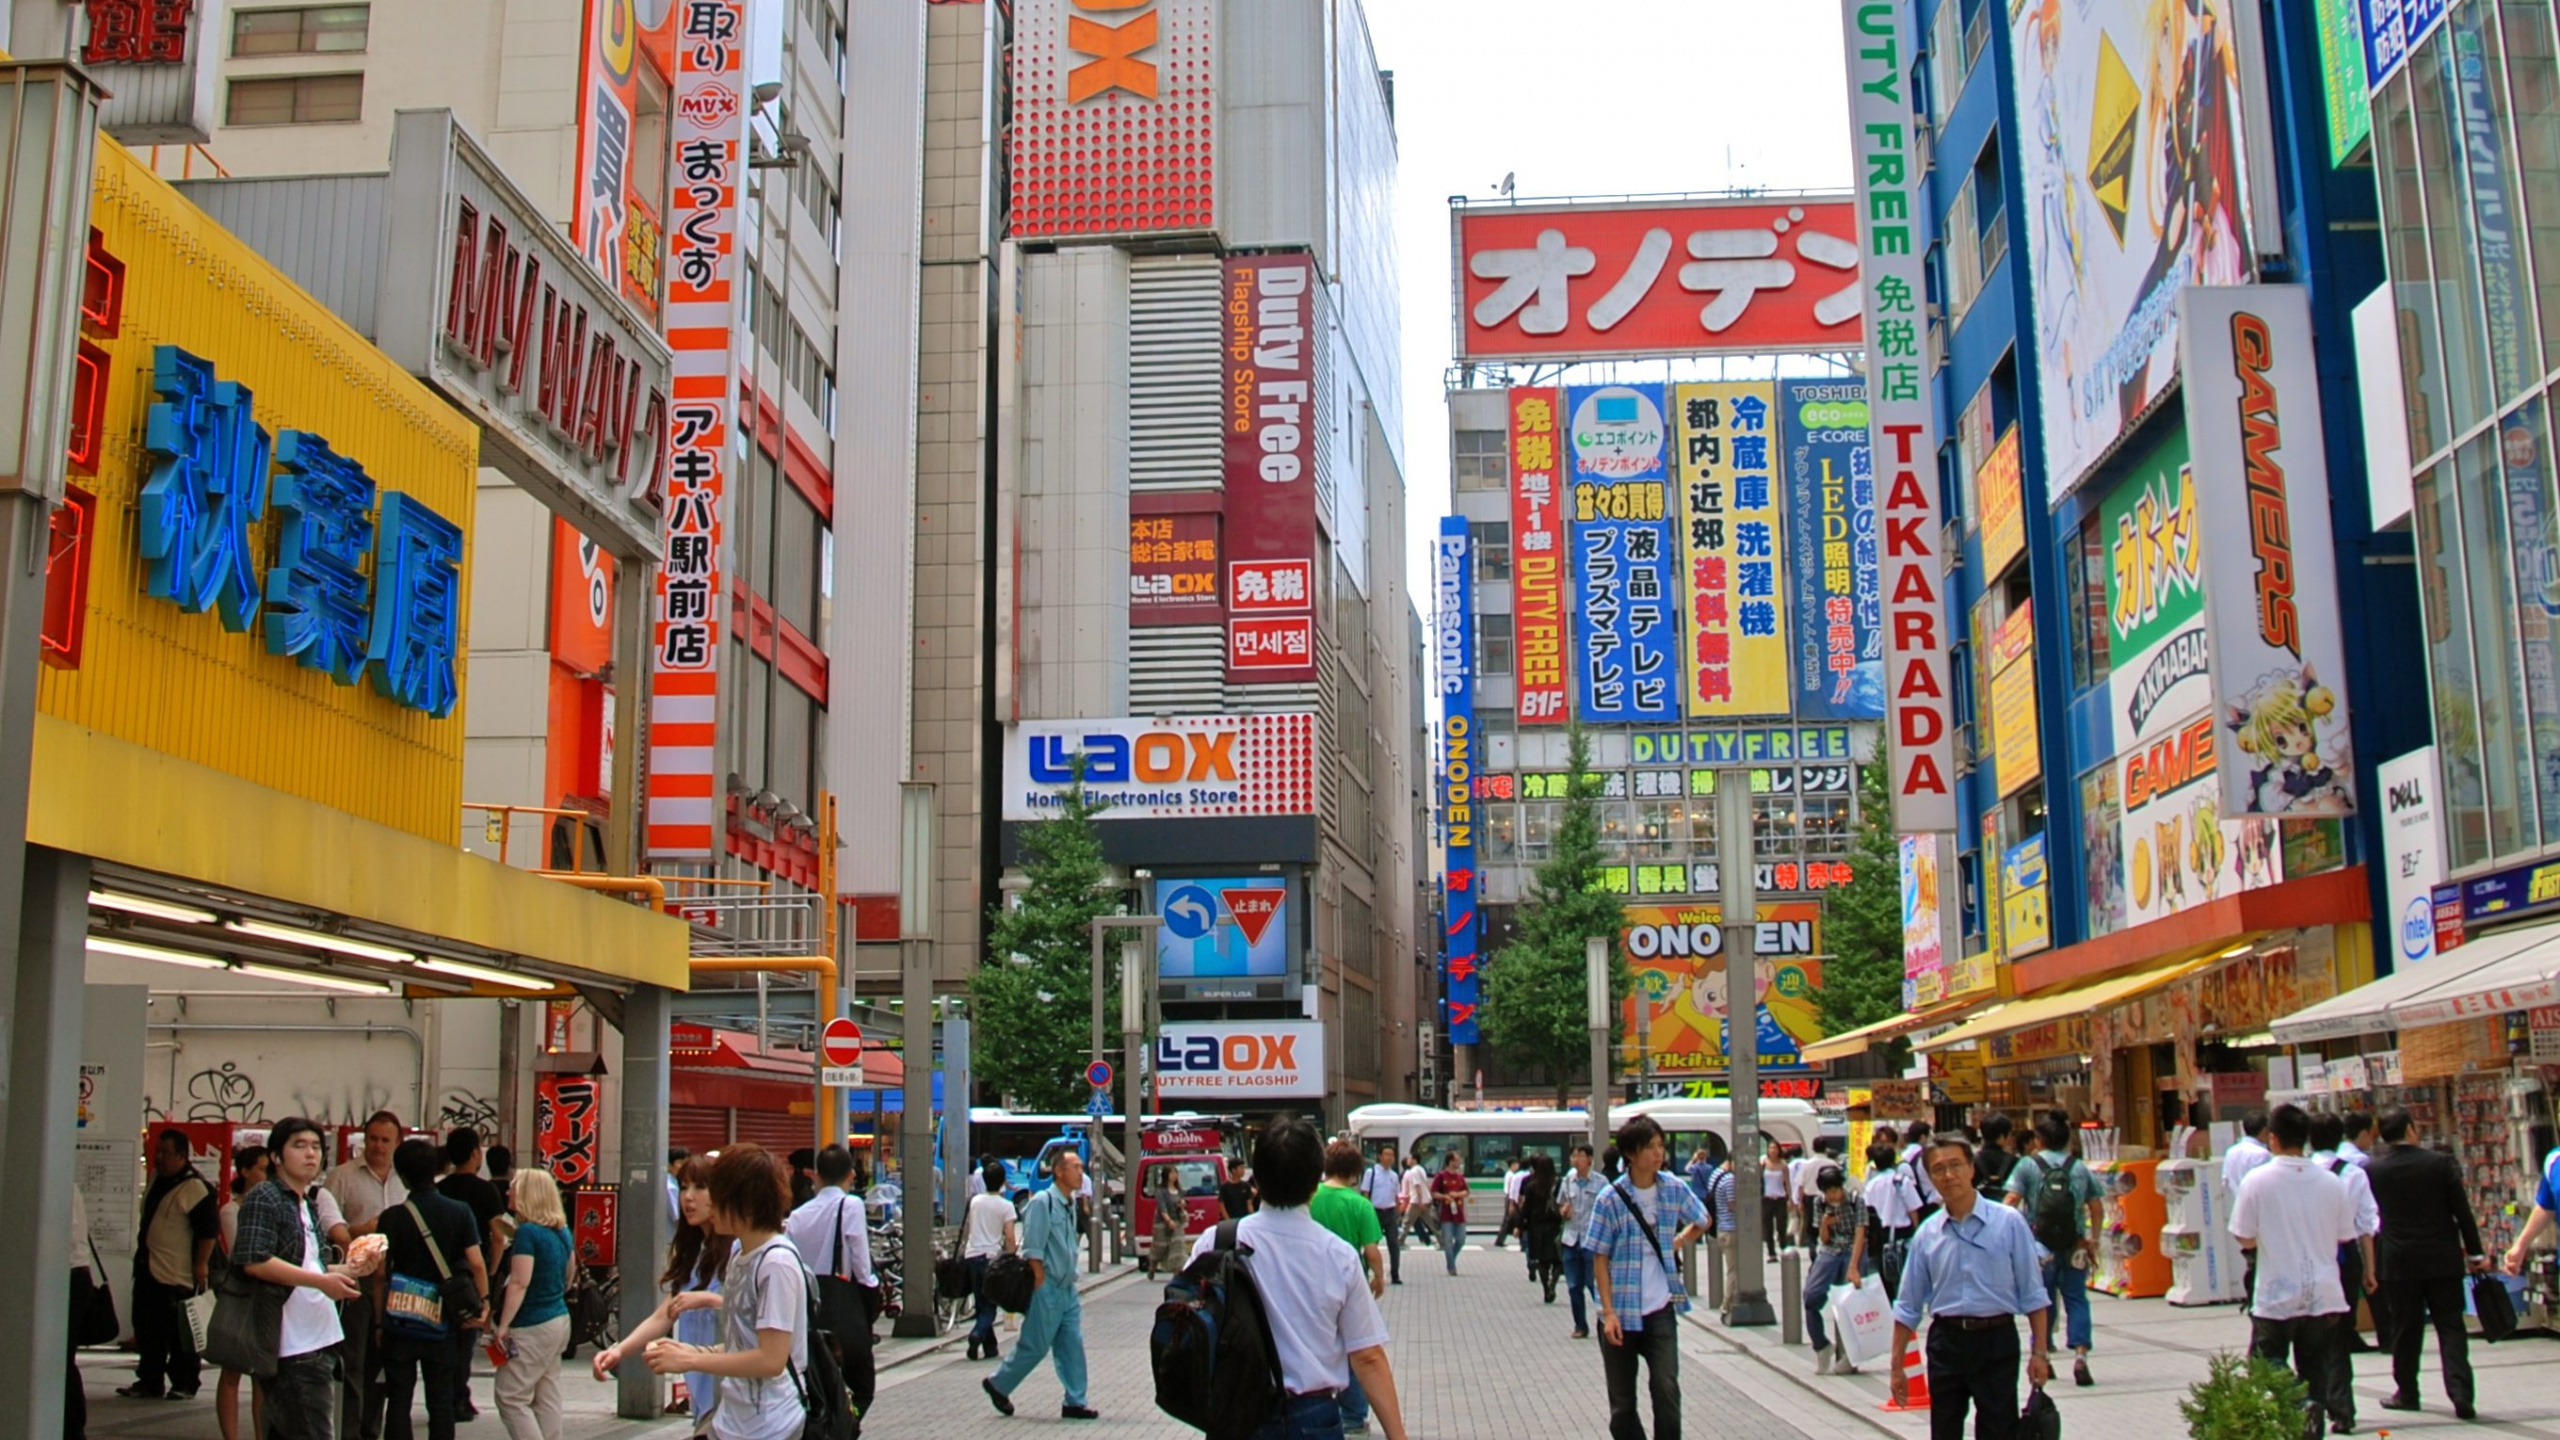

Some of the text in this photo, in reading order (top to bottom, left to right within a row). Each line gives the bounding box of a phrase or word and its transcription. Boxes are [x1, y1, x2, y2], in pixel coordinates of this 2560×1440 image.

[1856, 0, 1911, 257] UTY FREE
[682, 139, 725, 290] まっくす
[1229, 267, 1255, 433] Flagship Store
[1253, 266, 1308, 483] Duty Free
[1874, 275, 1919, 402] 免税店
[1515, 398, 1553, 471] 免税
[1577, 456, 1661, 473] オノデンポイント
[1594, 430, 1658, 446] エコポイント
[1807, 430, 1866, 443] E-CORE
[2230, 310, 2302, 664] GAMERS
[140, 344, 464, 720] 秋葉原
[665, 408, 714, 664] アキバ駅前店
[1131, 519, 1173, 540] 本店
[1131, 540, 1216, 563] 総合家電
[1730, 396, 1776, 638] 冷蔵庫 洗濯機
[1235, 629, 1307, 656] 면세점
[1236, 568, 1305, 602] 免税
[1441, 535, 1469, 695] Panasonic
[1520, 556, 1560, 686] DUTY FREE
[1585, 528, 1623, 712] プラズマテレビ
[1625, 529, 1665, 711] 液晶テレビ
[1883, 425, 1947, 796] TAKARADA
[1521, 691, 1563, 717] B1F
[1189, 788, 1239, 803] Store
[1446, 715, 1471, 847] ONODEN
[2389, 778, 2424, 814] DELL
[1234, 899, 1273, 914] 止まれ
[1446, 868, 1476, 1024] オノデン
[1628, 921, 1812, 958] ONOEN
[1228, 1075, 1299, 1086] FLAGSHIP
